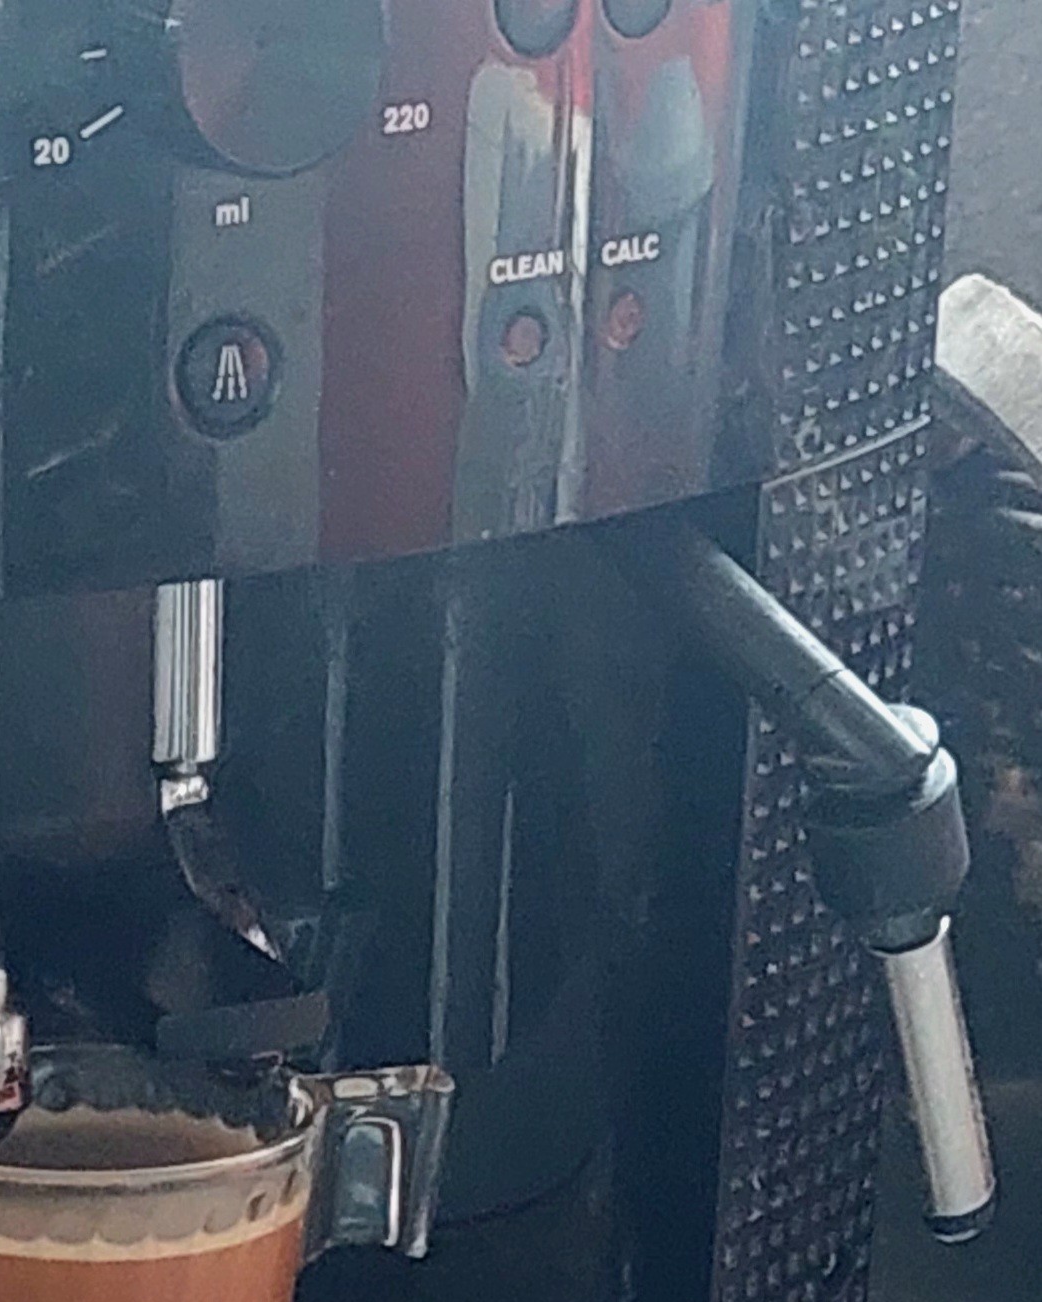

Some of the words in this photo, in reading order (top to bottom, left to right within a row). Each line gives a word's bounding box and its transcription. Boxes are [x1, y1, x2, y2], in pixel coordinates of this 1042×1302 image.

[383, 103, 429, 133] 220
[34, 137, 69, 164] 20
[215, 197, 249, 225] ml
[601, 233, 660, 265] CALC
[490, 250, 564, 284] CLEAN
